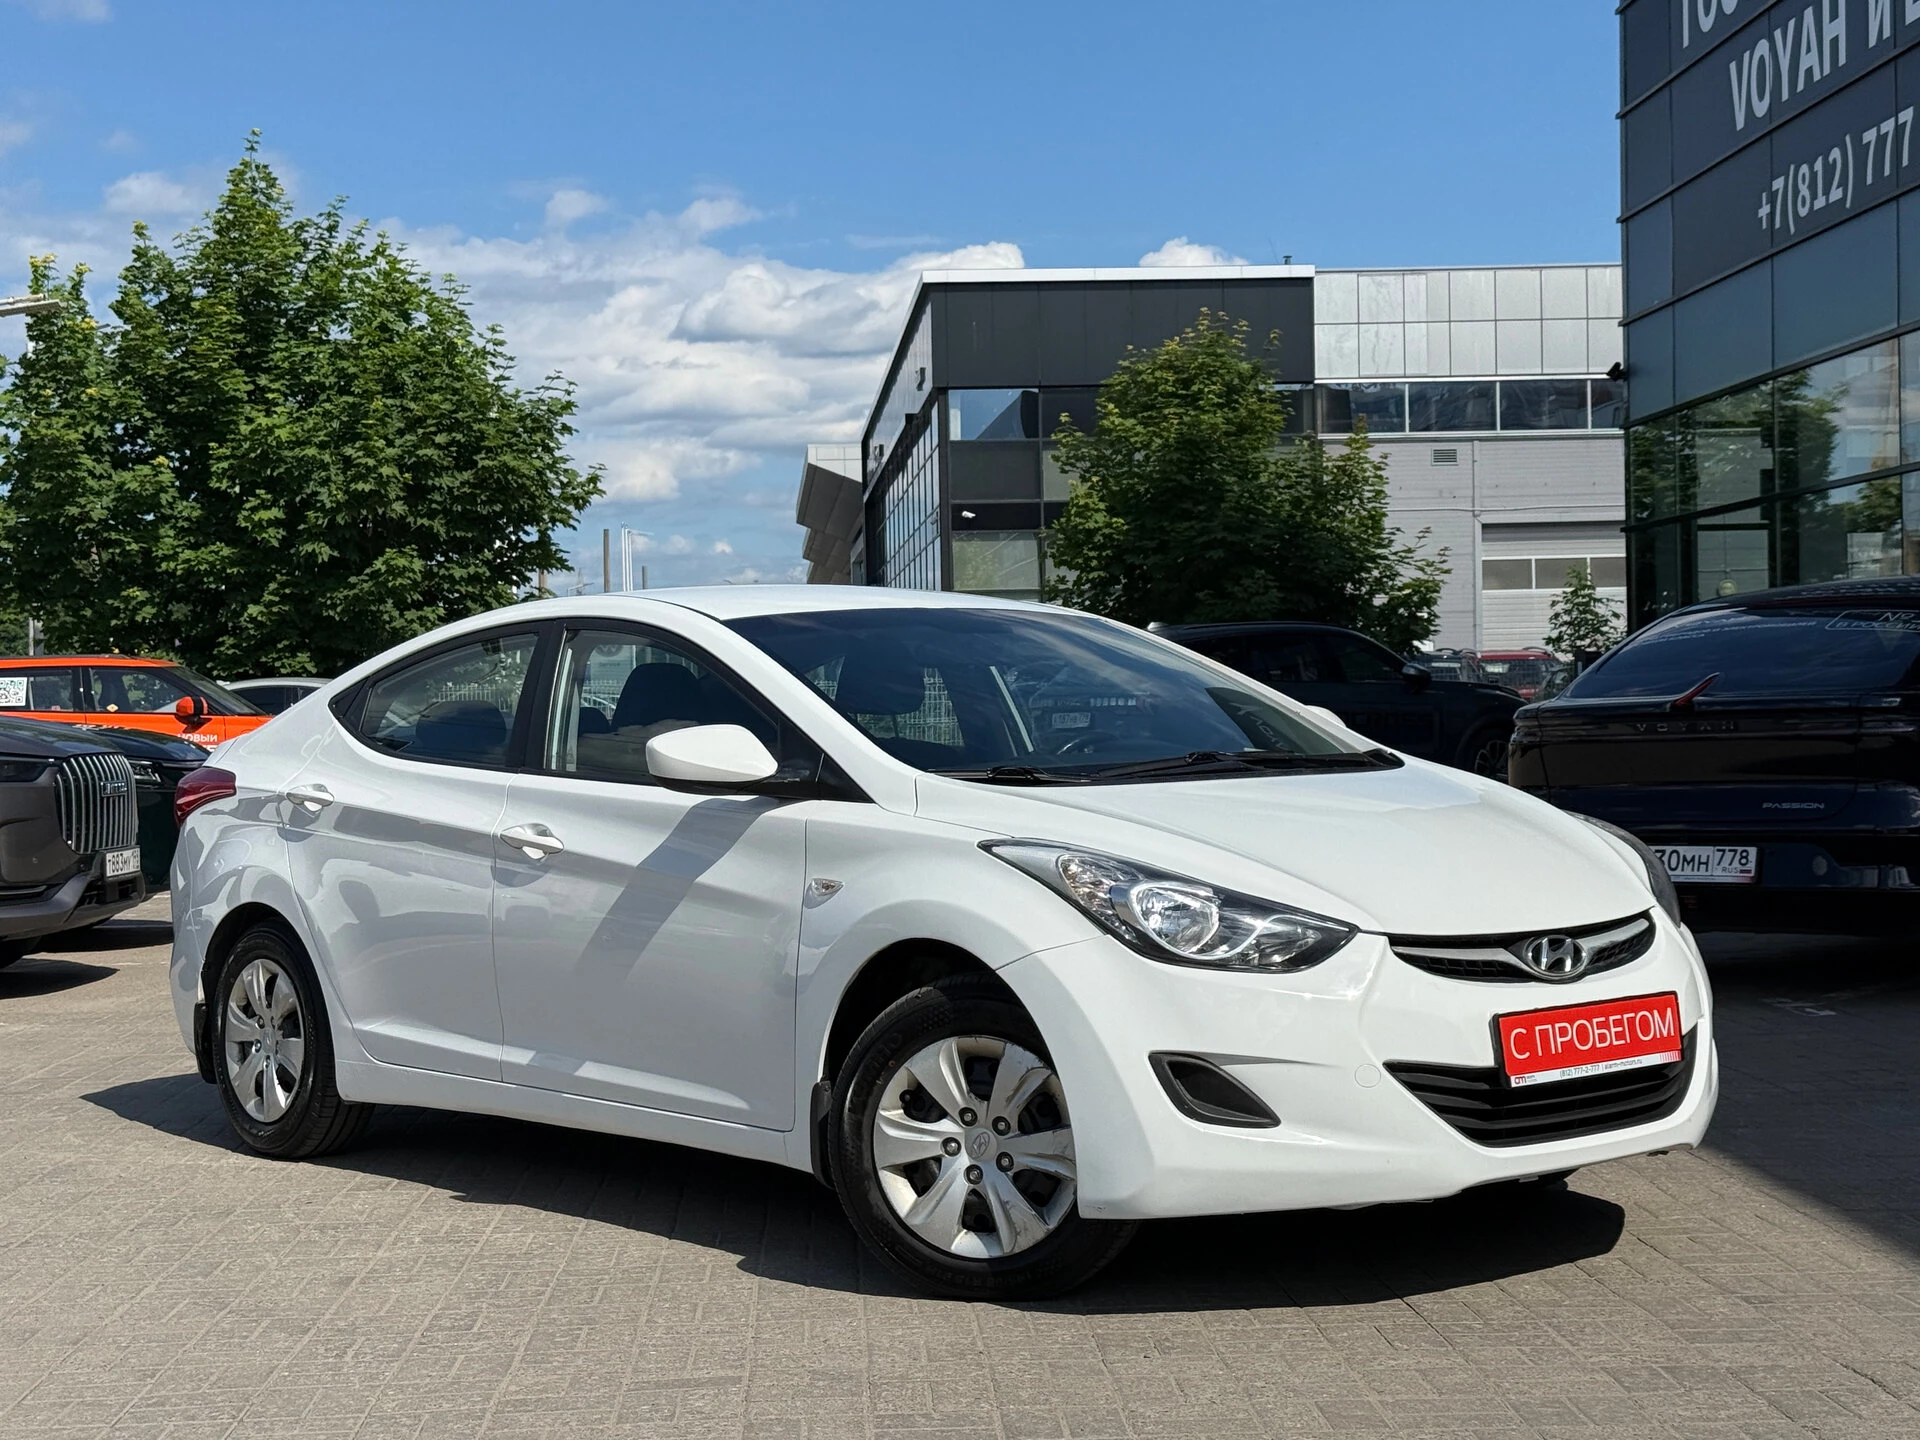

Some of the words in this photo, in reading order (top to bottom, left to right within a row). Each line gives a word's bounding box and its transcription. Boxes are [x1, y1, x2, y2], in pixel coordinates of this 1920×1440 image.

[1729, 0, 1847, 132] VOYAH
[1757, 133, 1854, 236] +7(812)
[1862, 105, 1915, 187] 777
[1635, 719, 1736, 732] VOYAH
[1715, 848, 1750, 867] 778
[1721, 866, 1739, 874] RUS
[1510, 1027, 1530, 1060] С
[1534, 1007, 1675, 1057] ПРОБЕГОМ
